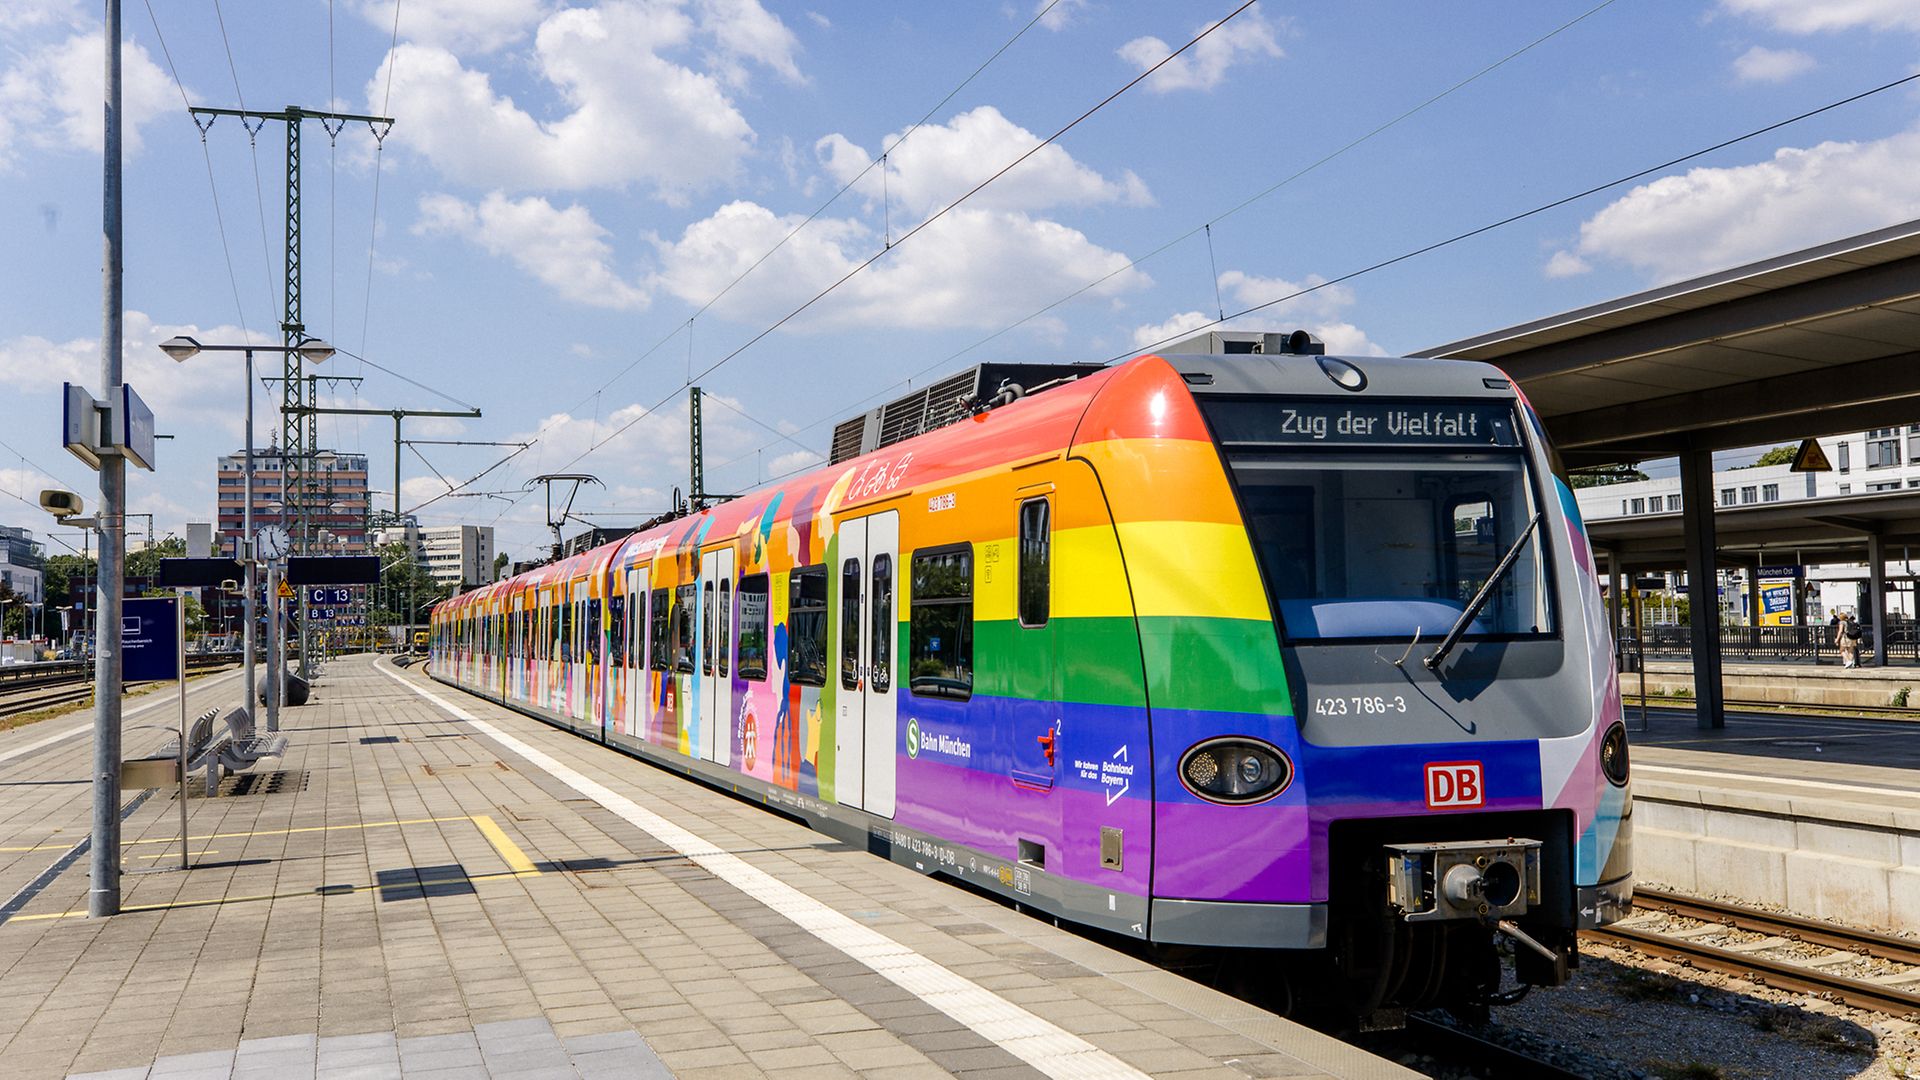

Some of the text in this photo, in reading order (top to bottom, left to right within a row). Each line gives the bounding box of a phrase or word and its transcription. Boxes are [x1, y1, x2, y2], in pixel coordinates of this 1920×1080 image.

[1281, 409, 1477, 439] Zug der Vielfalt
[1757, 567, 1793, 576] München Ost
[314, 589, 348, 601] C 13
[311, 609, 334, 618] B 13
[1315, 696, 1407, 715] 423 786-3
[1056, 718, 1062, 736] 2
[920, 731, 938, 752] Bahn
[938, 734, 971, 758] München
[1088, 771, 1097, 779] das
[1102, 761, 1134, 776] Bahnland
[1101, 773, 1124, 786] Bayern
[1432, 769, 1478, 803] DB
